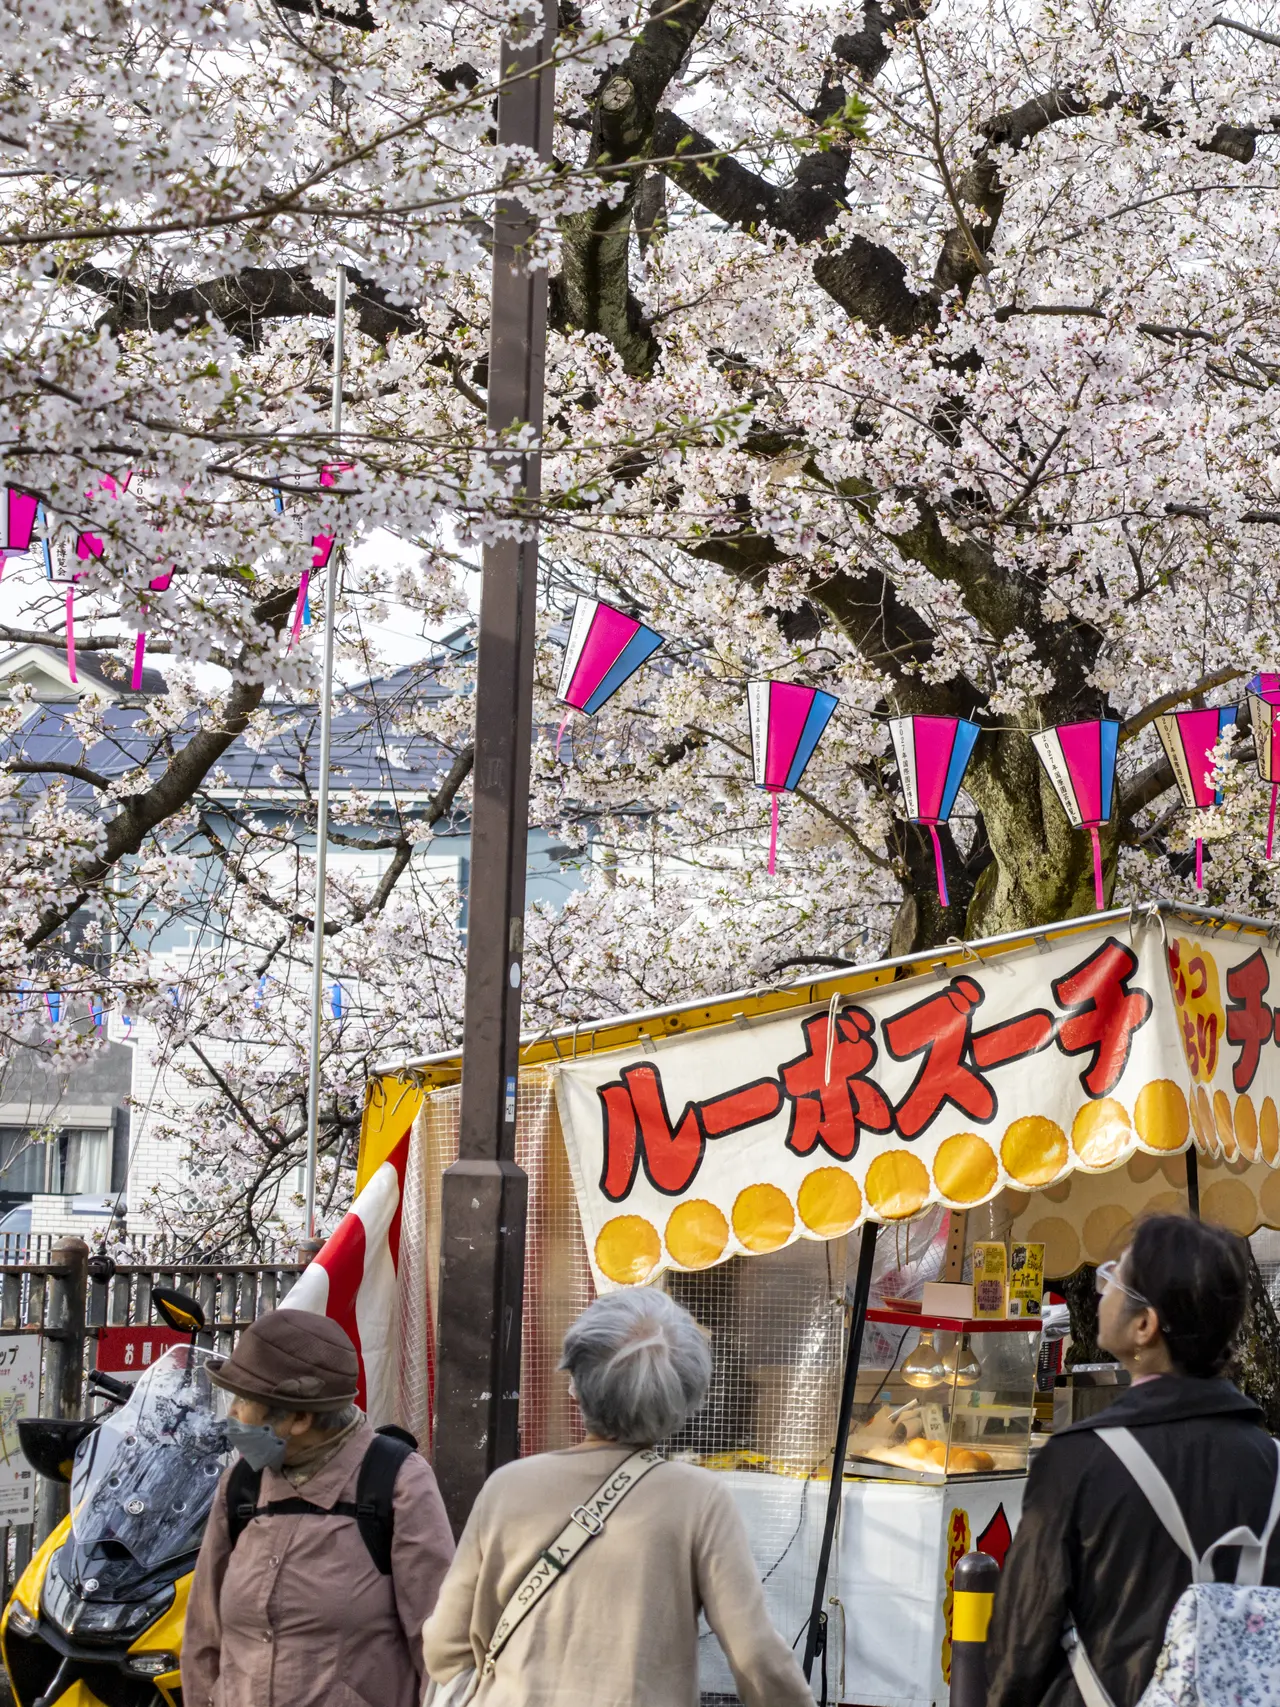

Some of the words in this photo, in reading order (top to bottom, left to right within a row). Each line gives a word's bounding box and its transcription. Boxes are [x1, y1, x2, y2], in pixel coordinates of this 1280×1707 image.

[898, 721, 915, 815] 2027年国際園芸博覧会
[1042, 735, 1078, 823] 2027年国際園芸博覧会
